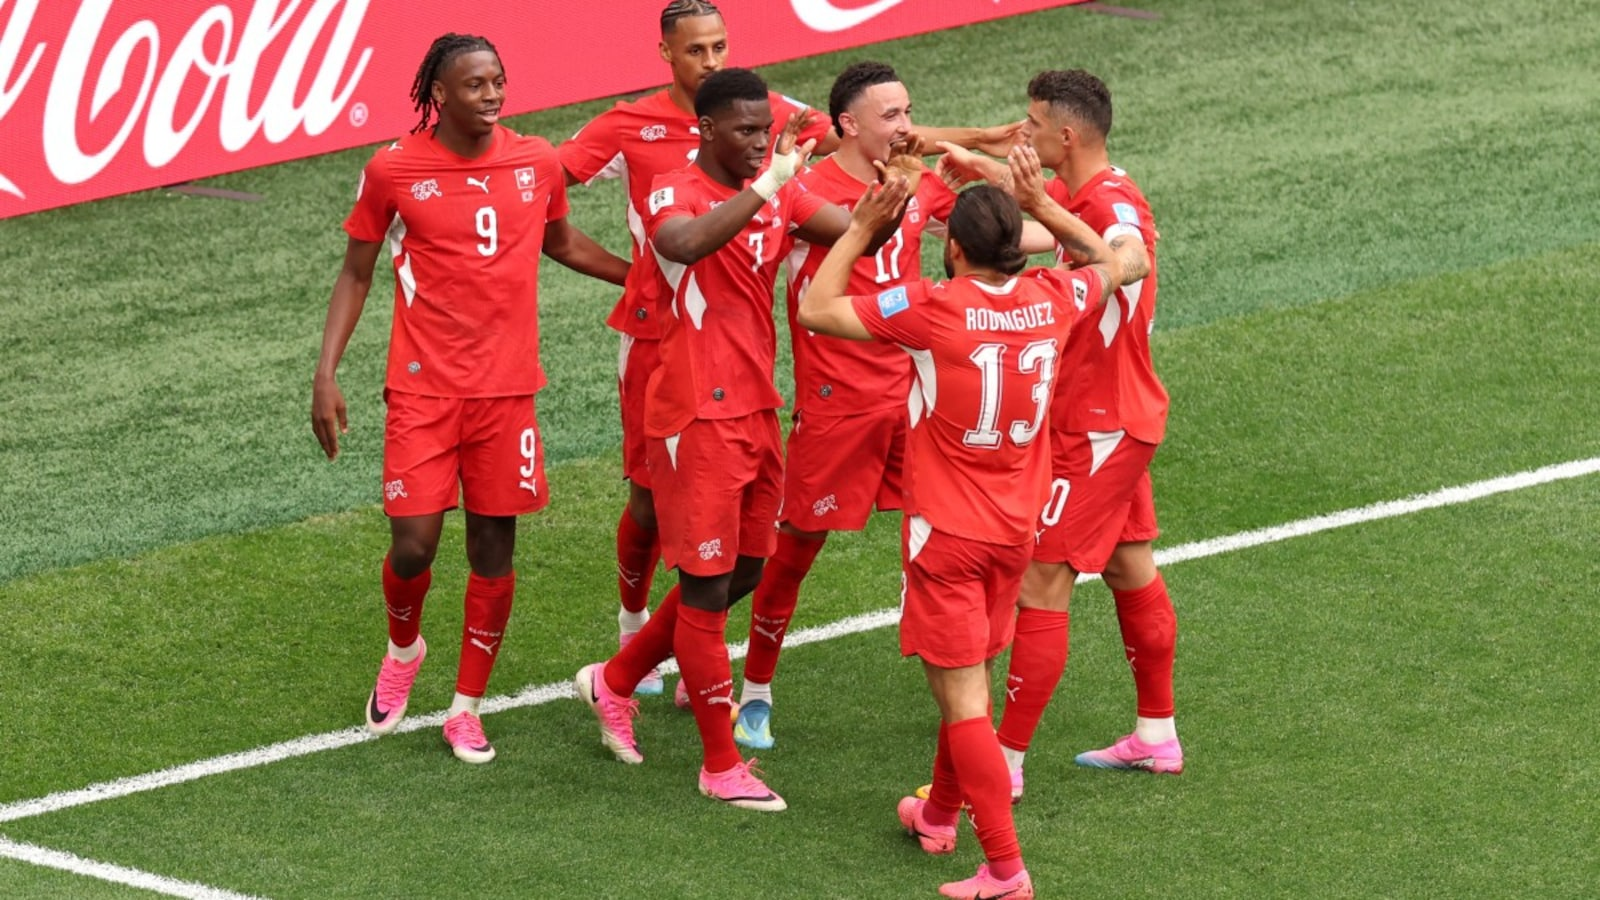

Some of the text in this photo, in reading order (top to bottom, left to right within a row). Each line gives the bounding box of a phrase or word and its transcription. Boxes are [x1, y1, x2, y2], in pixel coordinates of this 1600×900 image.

[475, 206, 498, 257] 9
[748, 232, 765, 274] 7
[874, 226, 904, 284] 17
[962, 337, 1058, 449] 13
[519, 427, 537, 479] 9
